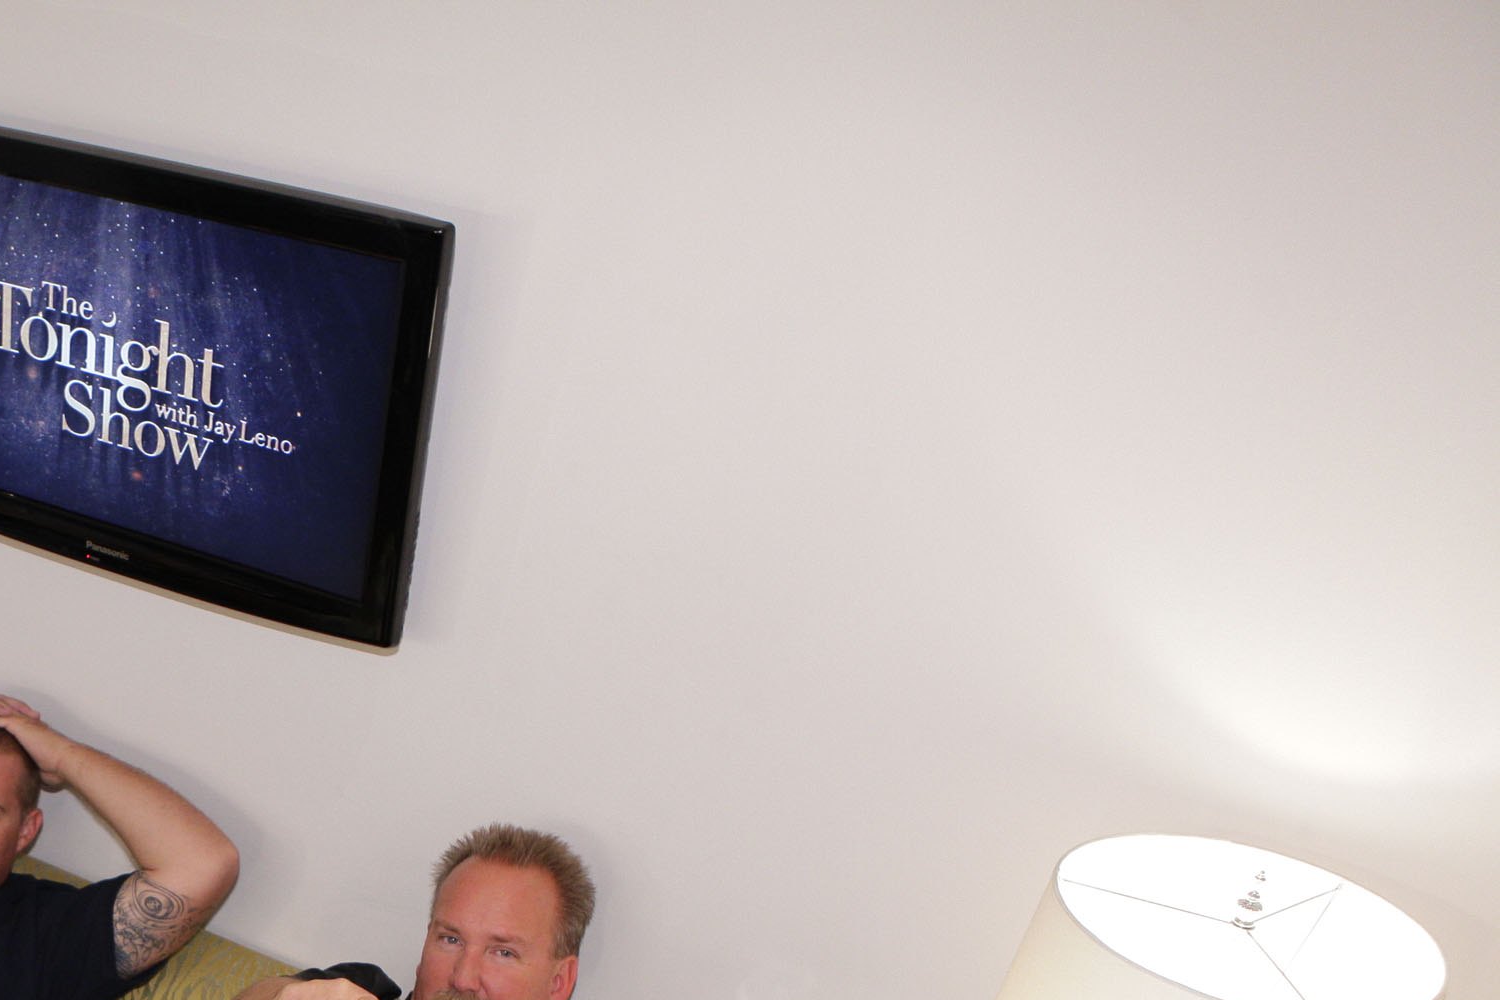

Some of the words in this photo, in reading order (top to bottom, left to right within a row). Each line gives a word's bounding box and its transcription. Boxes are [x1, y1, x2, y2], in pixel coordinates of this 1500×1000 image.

[41, 280, 94, 320] The
[62, 379, 215, 471] Show
[155, 400, 199, 429] with
[204, 410, 237, 446] Jay
[238, 419, 294, 456] Leno
[86, 540, 130, 561] Panasonic
